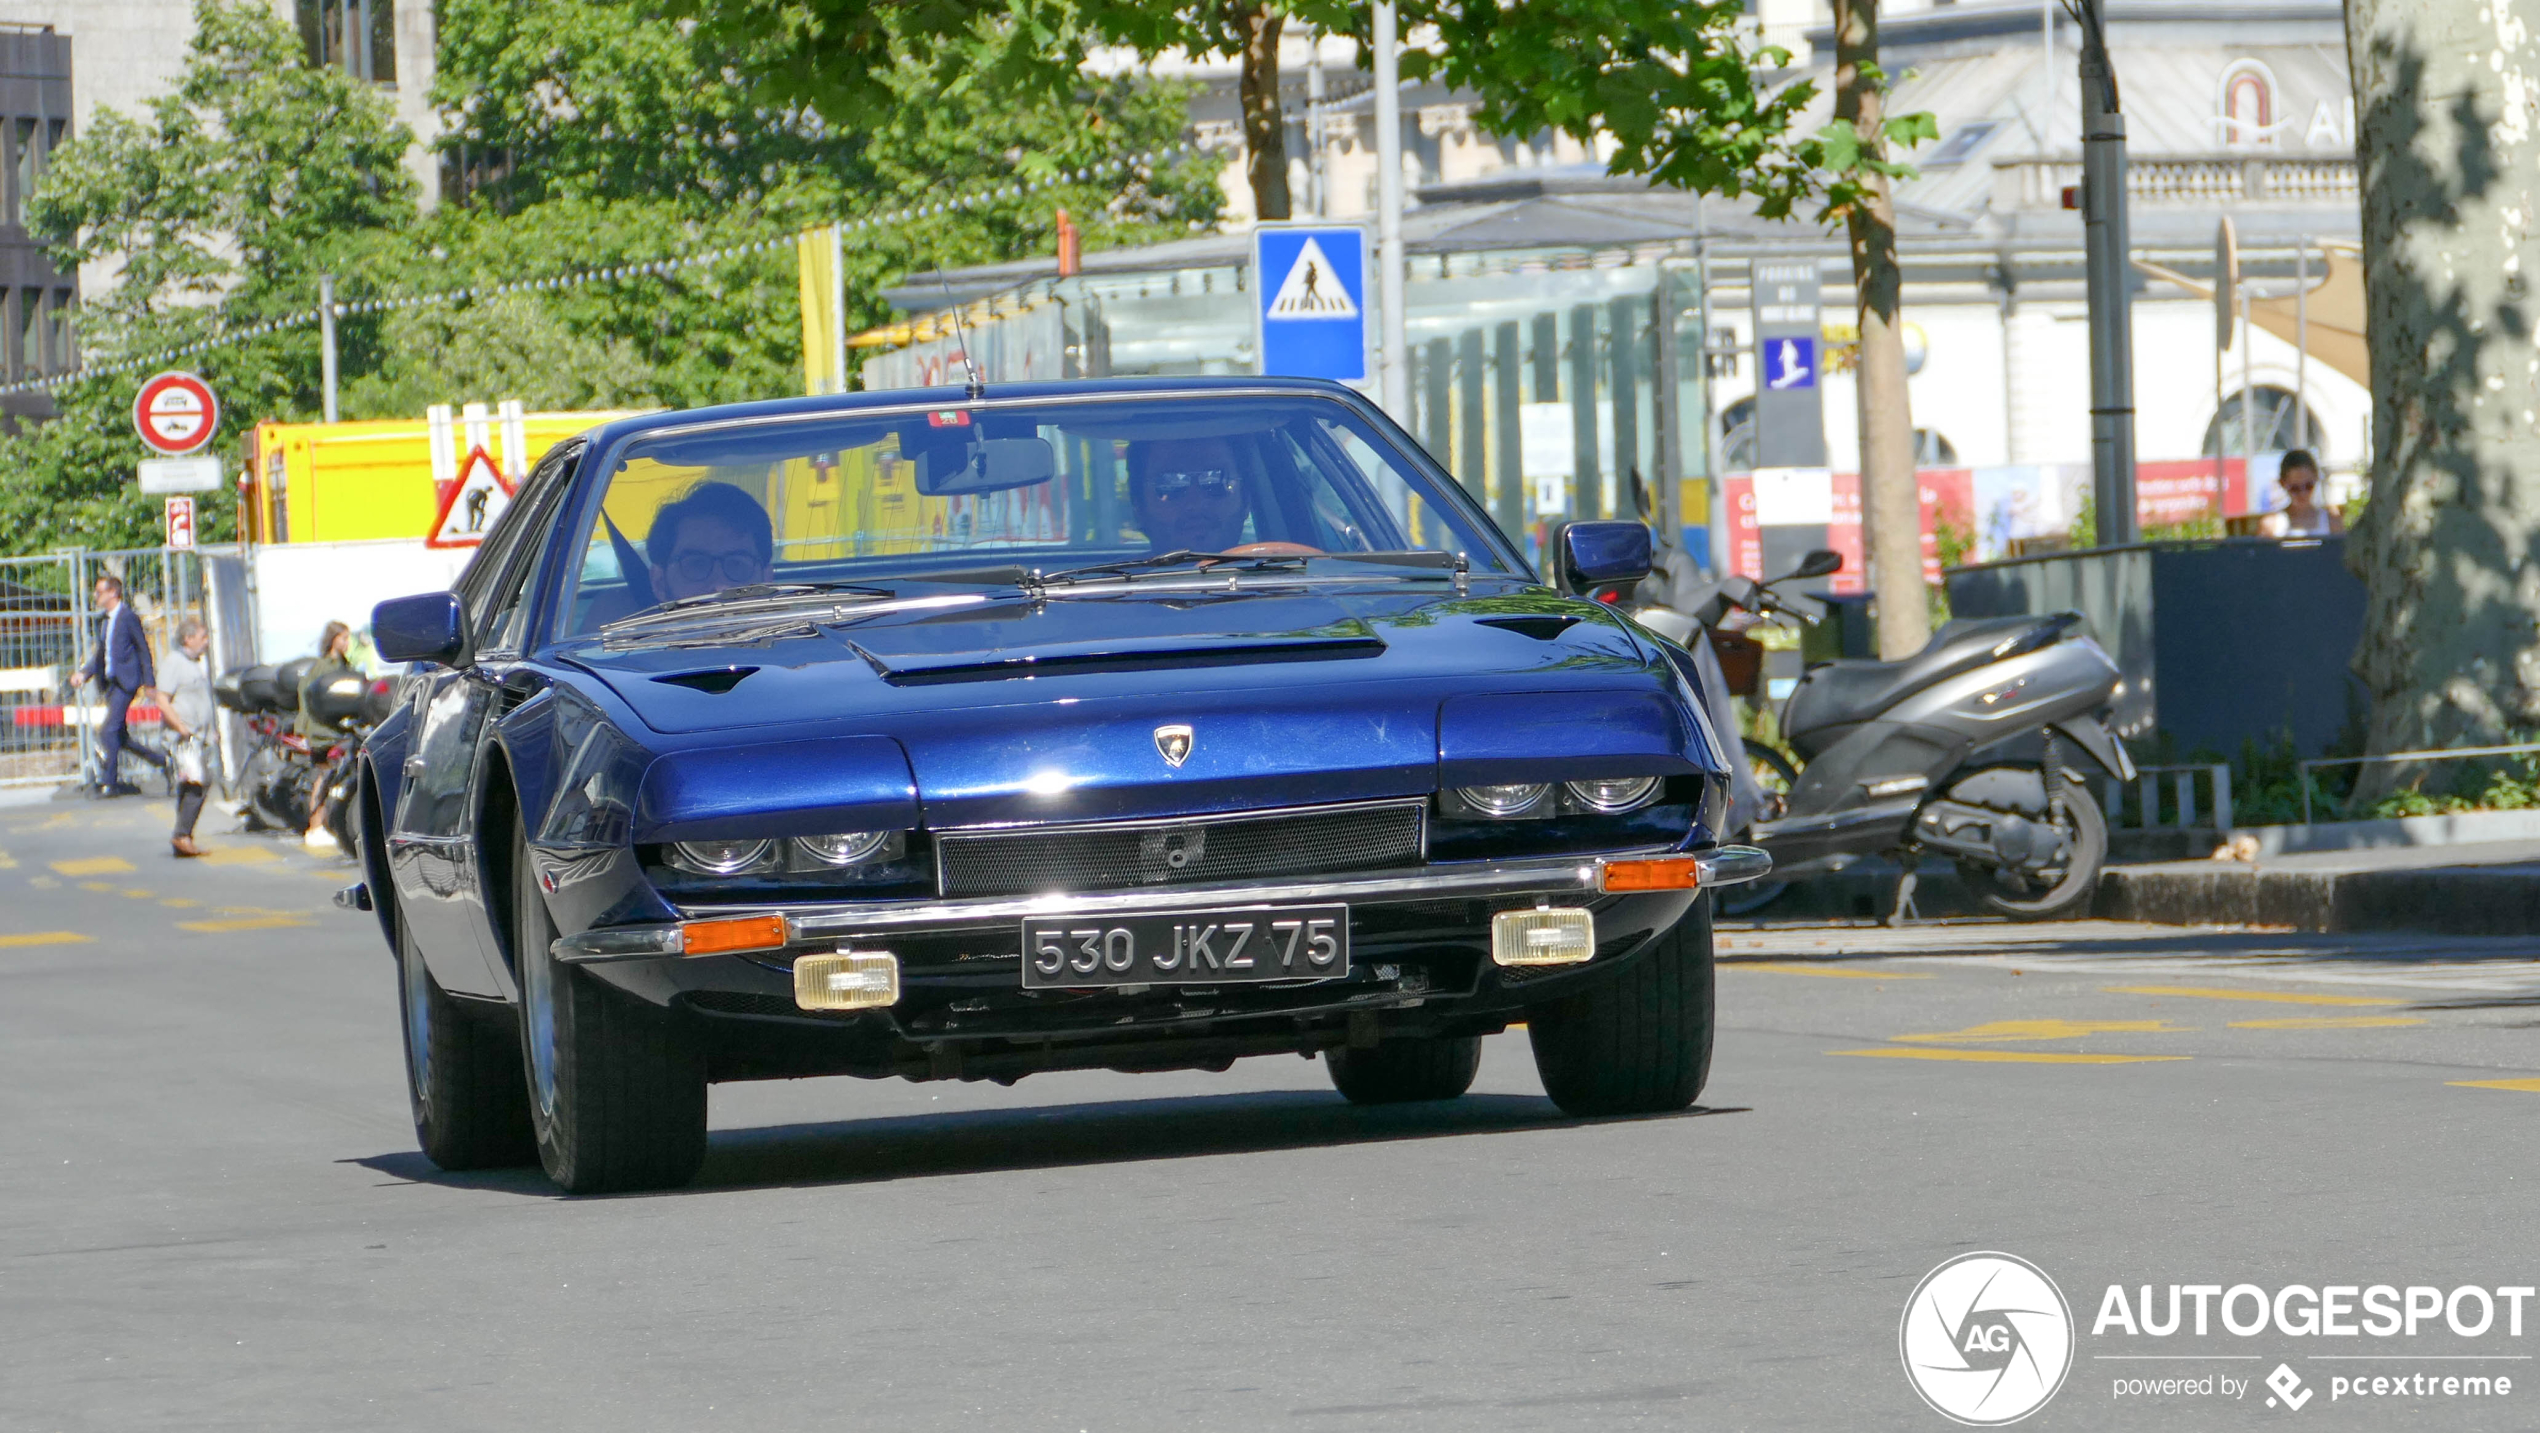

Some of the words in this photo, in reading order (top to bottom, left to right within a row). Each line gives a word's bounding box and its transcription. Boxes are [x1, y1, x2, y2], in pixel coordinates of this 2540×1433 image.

[1035, 927, 1134, 975] 530
[1152, 923, 1254, 970] JKZ
[1271, 919, 1338, 966] 75
